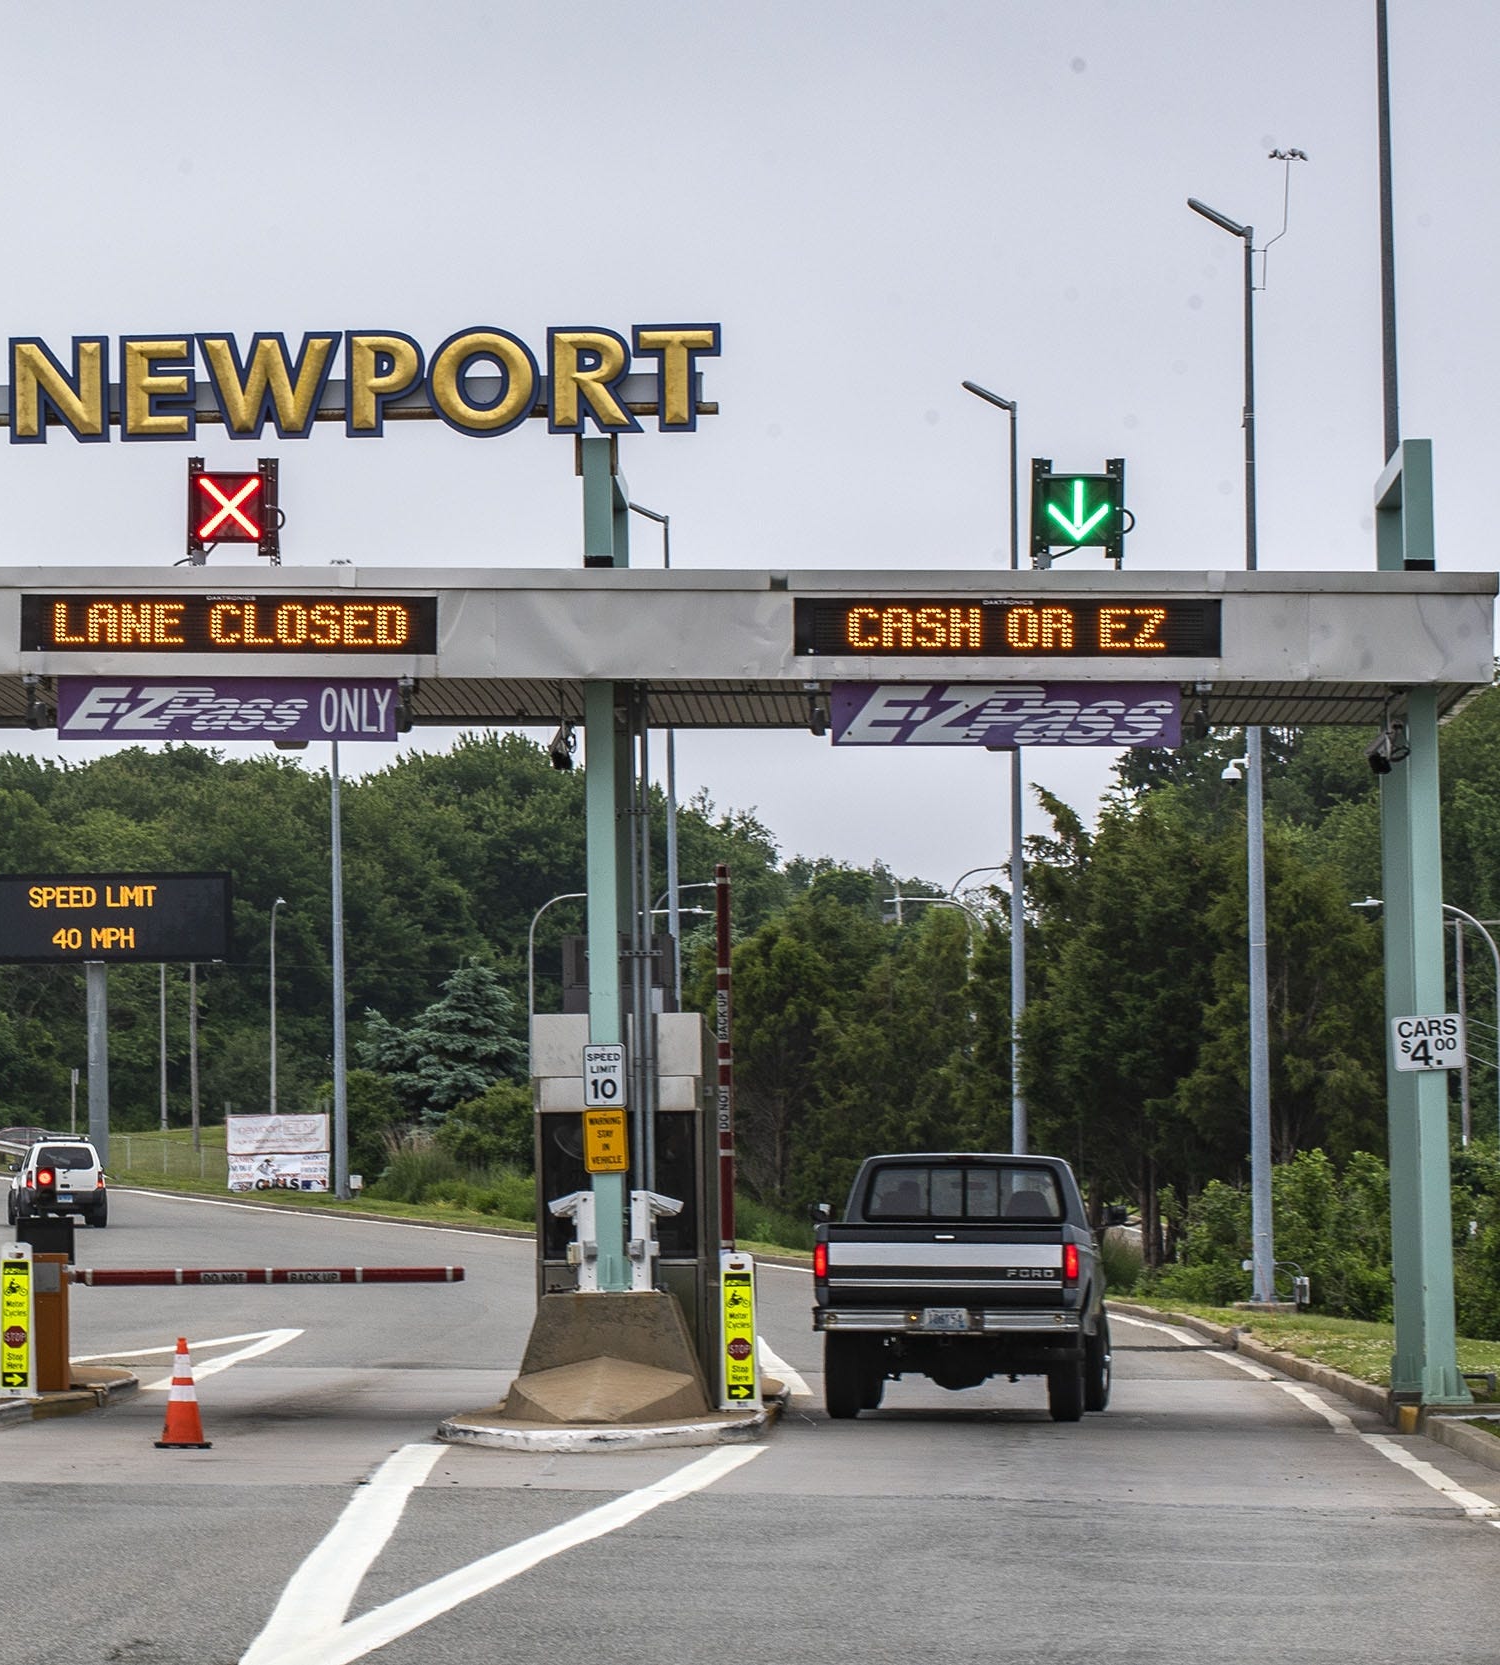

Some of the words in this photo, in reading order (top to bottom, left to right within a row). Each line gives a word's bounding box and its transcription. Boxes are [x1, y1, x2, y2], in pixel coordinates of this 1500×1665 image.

[8, 323, 721, 444] NEWPORT
[55, 603, 185, 643] LANE
[211, 604, 407, 645] CLOSED
[847, 608, 980, 648] CASH
[1008, 608, 1073, 648] OR
[1099, 608, 1165, 648] EZ
[319, 687, 393, 733] ONLY
[28, 886, 97, 908] SPEED
[106, 886, 156, 907] LIMIT
[52, 927, 82, 949] 40
[90, 927, 135, 949] MPH
[718, 993, 727, 1007] UP
[718, 1010, 727, 1040] BACK
[1398, 1018, 1457, 1038] CARS
[587, 1053, 621, 1062] SPEED
[590, 1065, 617, 1074] LIMIT
[591, 1079, 617, 1099] 10
[719, 1090, 728, 1111] NOT
[588, 1117, 621, 1125] WARNING
[719, 1115, 728, 1129] DO
[597, 1130, 613, 1138] STAY
[602, 1143, 610, 1151] IN
[591, 1155, 622, 1164] VEHICLE
[203, 1274, 219, 1283] DO
[221, 1274, 244, 1283] NOT
[290, 1273, 320, 1282] BACK
[322, 1273, 338, 1281] UP
[1007, 1269, 1055, 1278] FORD
[4, 1310, 27, 1318] Cycles
[727, 1321, 750, 1330] Cycles
[4, 1332, 26, 1342] STOP
[729, 1343, 750, 1354] STOP
[6, 1353, 23, 1361] Stop
[732, 1365, 749, 1374] Stop
